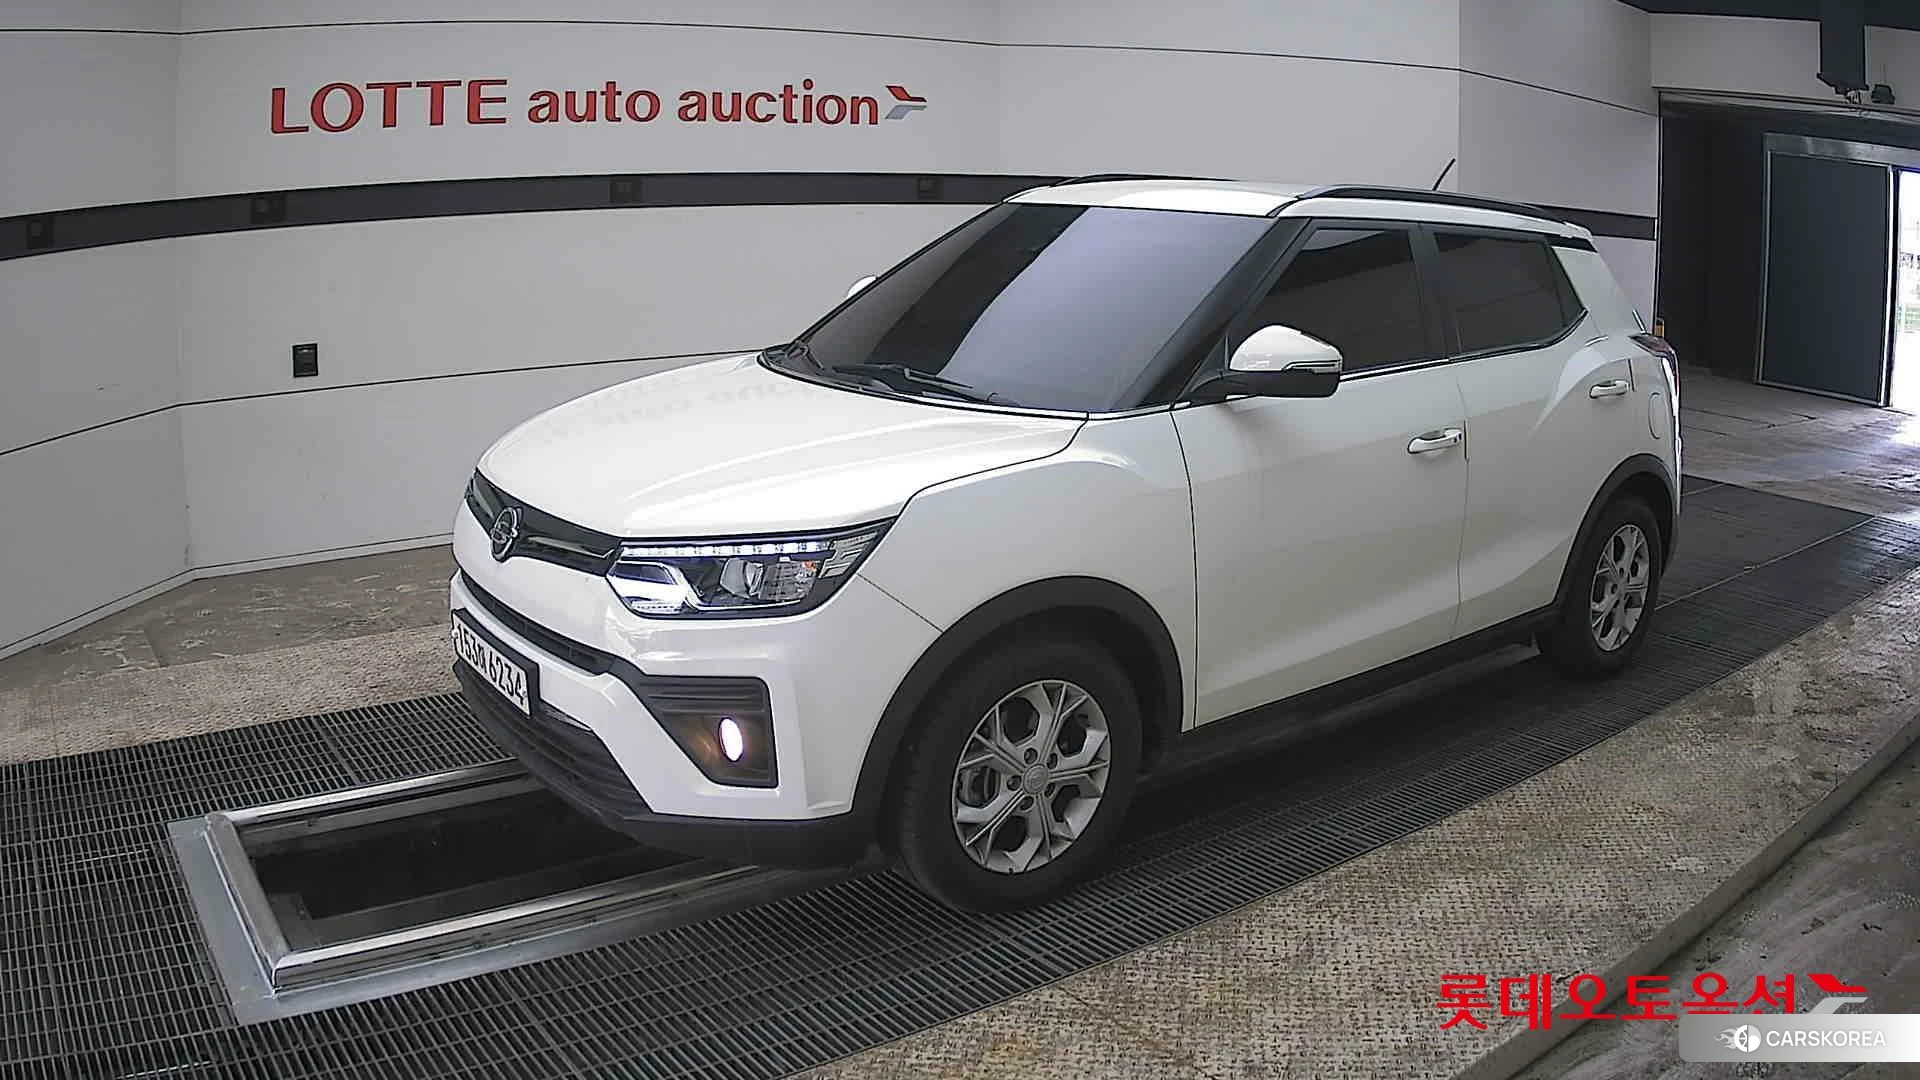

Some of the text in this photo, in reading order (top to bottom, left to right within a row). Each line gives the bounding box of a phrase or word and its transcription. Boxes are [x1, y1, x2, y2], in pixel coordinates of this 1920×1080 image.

[271, 78, 880, 134] LOTTE auto auction
[489, 650, 525, 706] 6234
